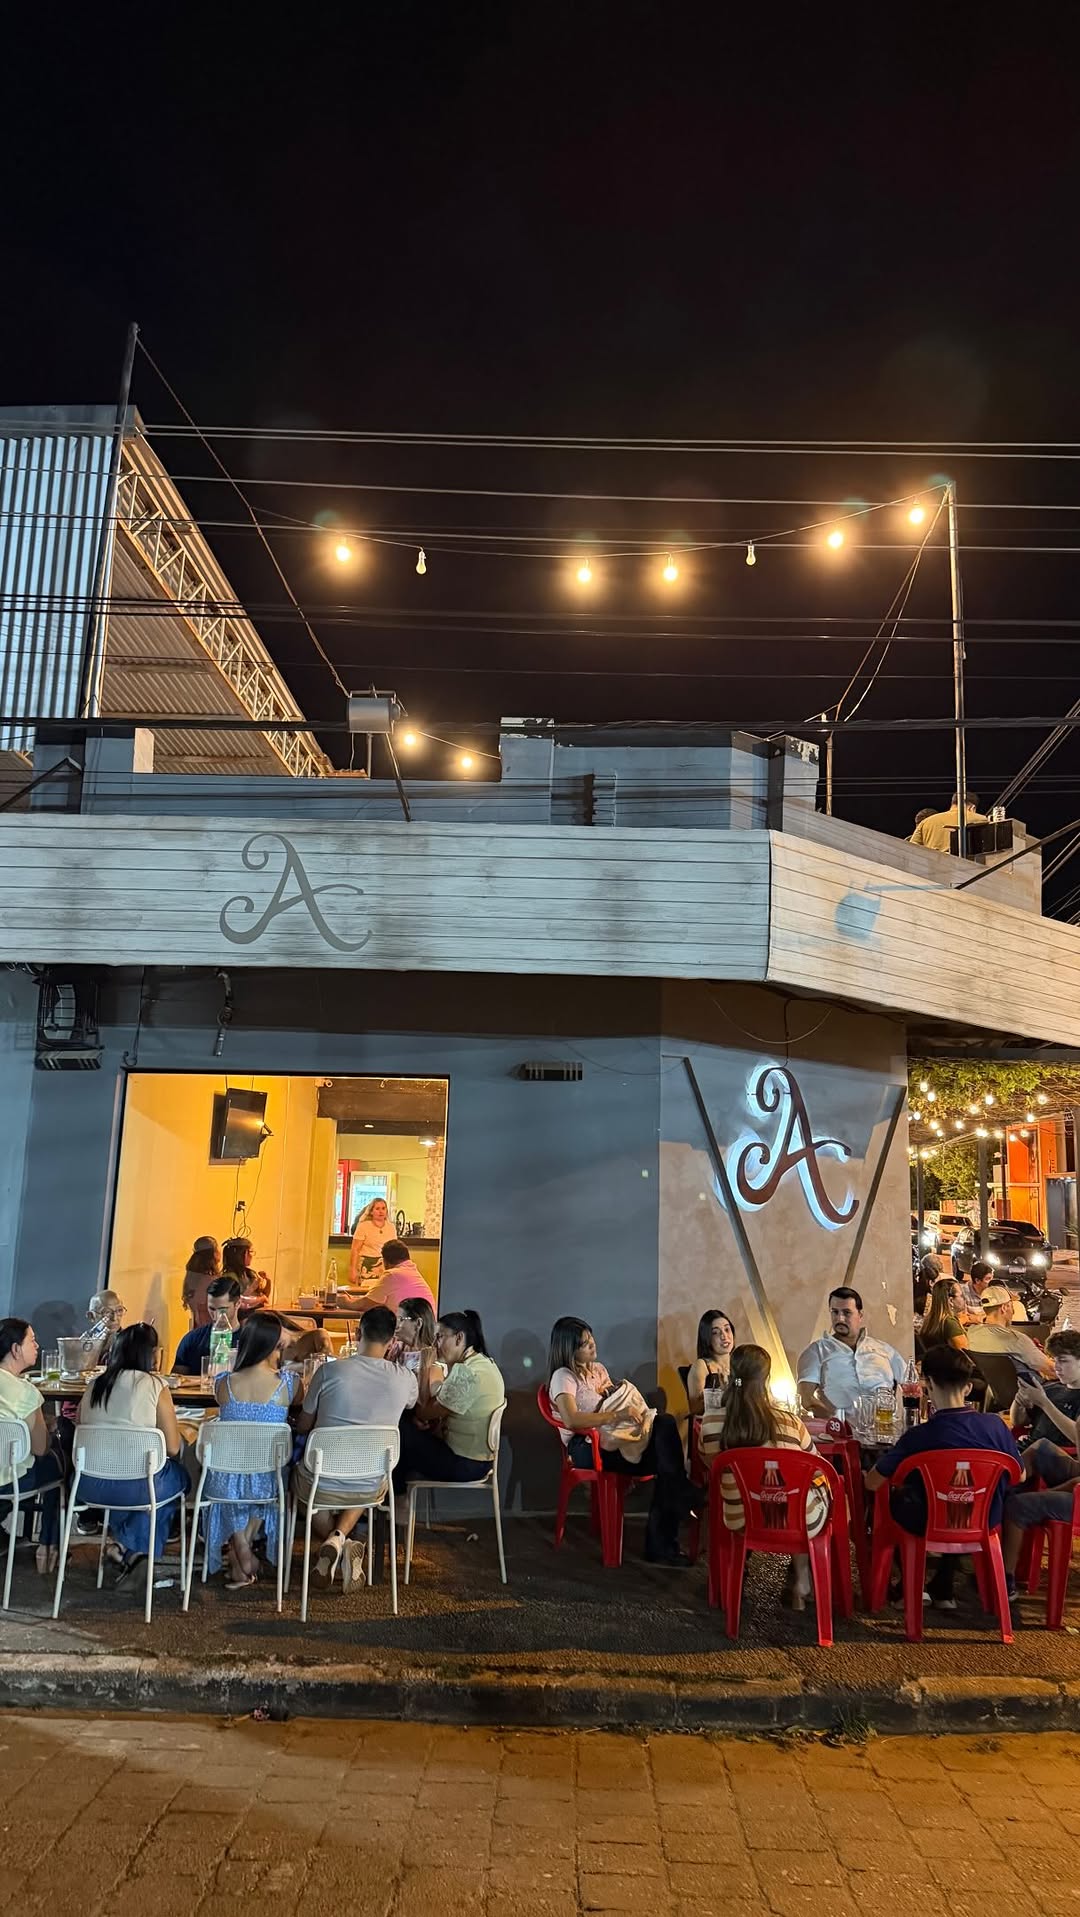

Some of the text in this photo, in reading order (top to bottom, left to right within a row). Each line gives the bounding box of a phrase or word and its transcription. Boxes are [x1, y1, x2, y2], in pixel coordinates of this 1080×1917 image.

[219, 833, 373, 952] A
[737, 1066, 860, 1224] A
[829, 1420, 841, 1432] 39
